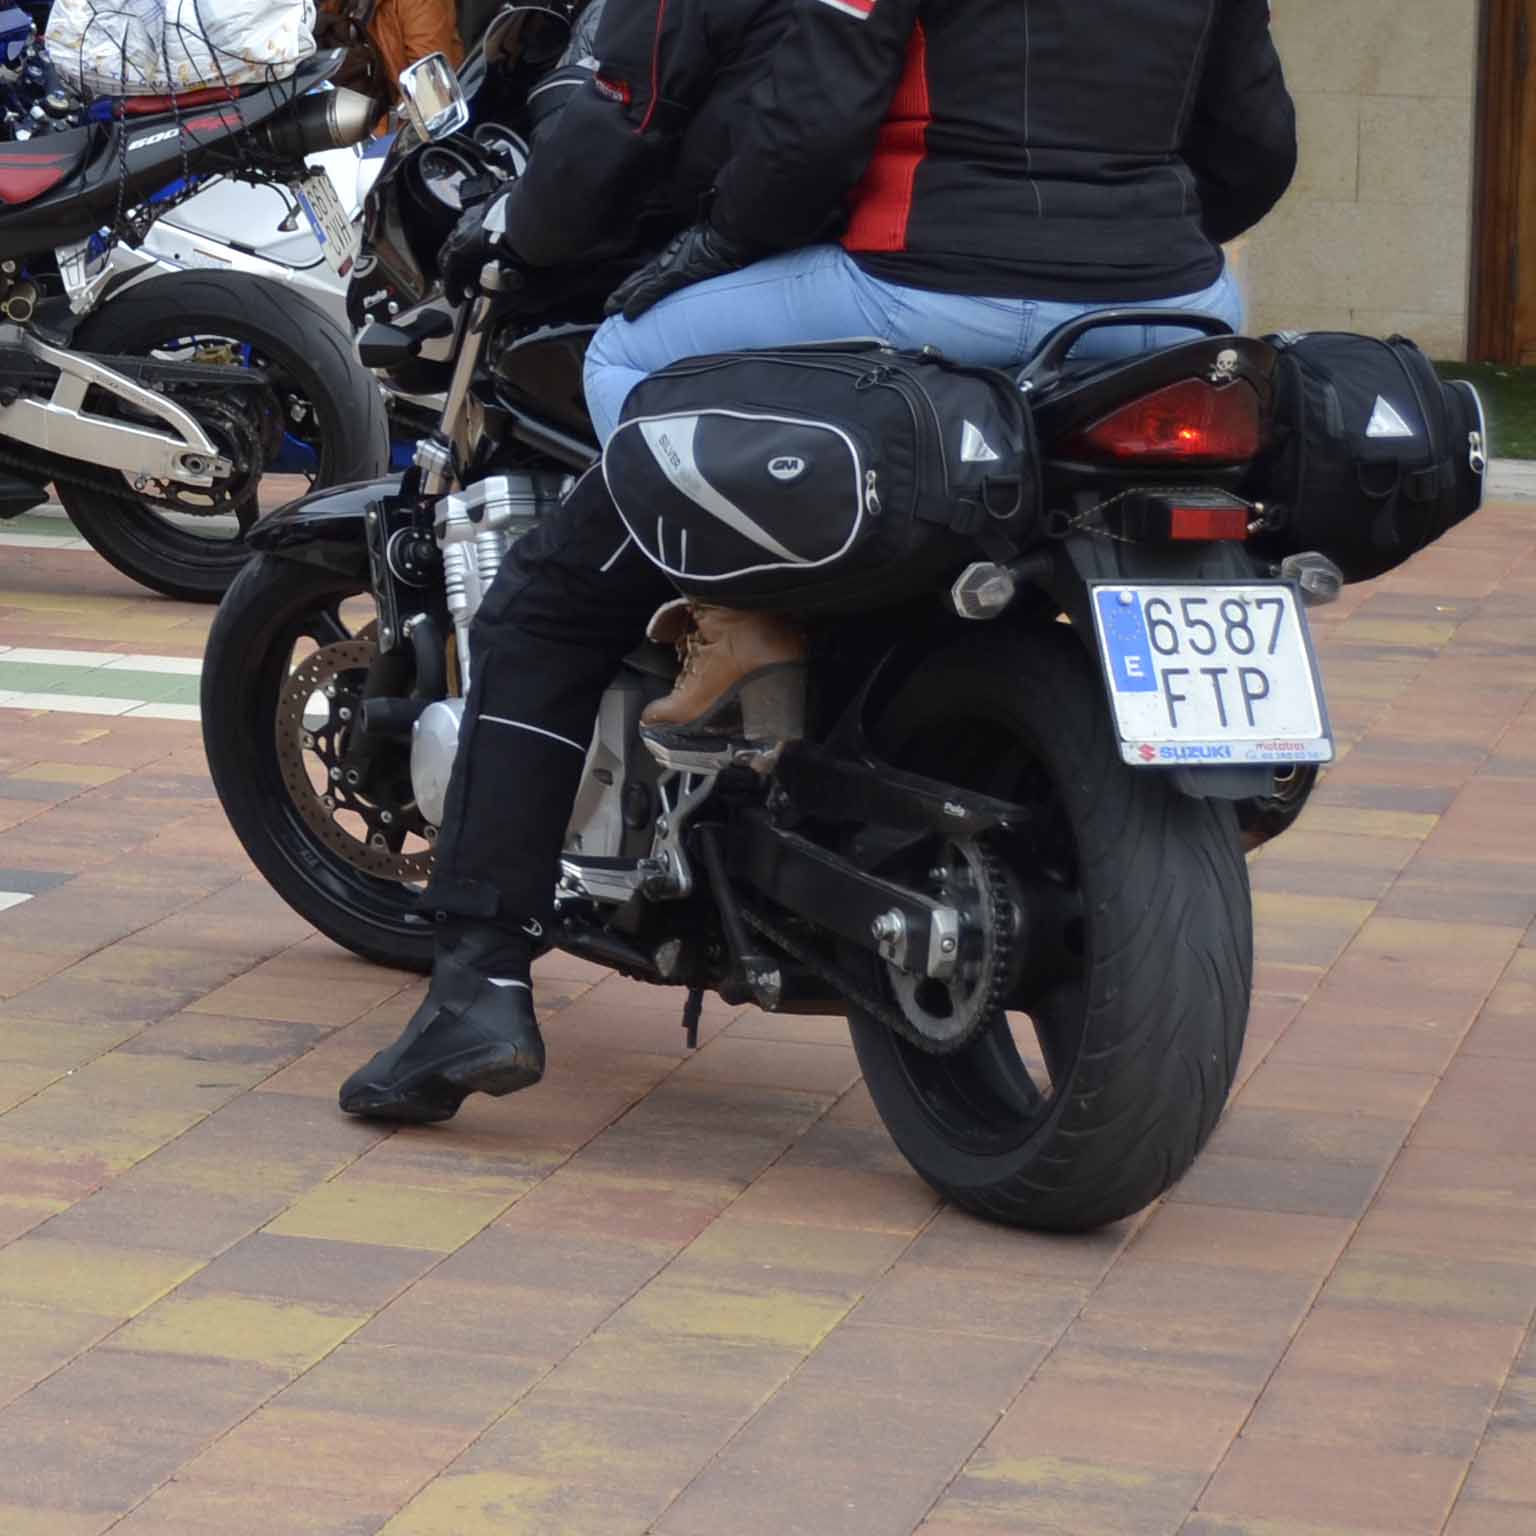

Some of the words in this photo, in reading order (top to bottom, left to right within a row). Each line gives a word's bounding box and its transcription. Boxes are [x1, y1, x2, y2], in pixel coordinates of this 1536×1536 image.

[1143, 597, 1285, 656] 6587
[1123, 655, 1145, 678] E
[1161, 667, 1270, 728] FTP
[1160, 745, 1232, 760] SUZUKI
